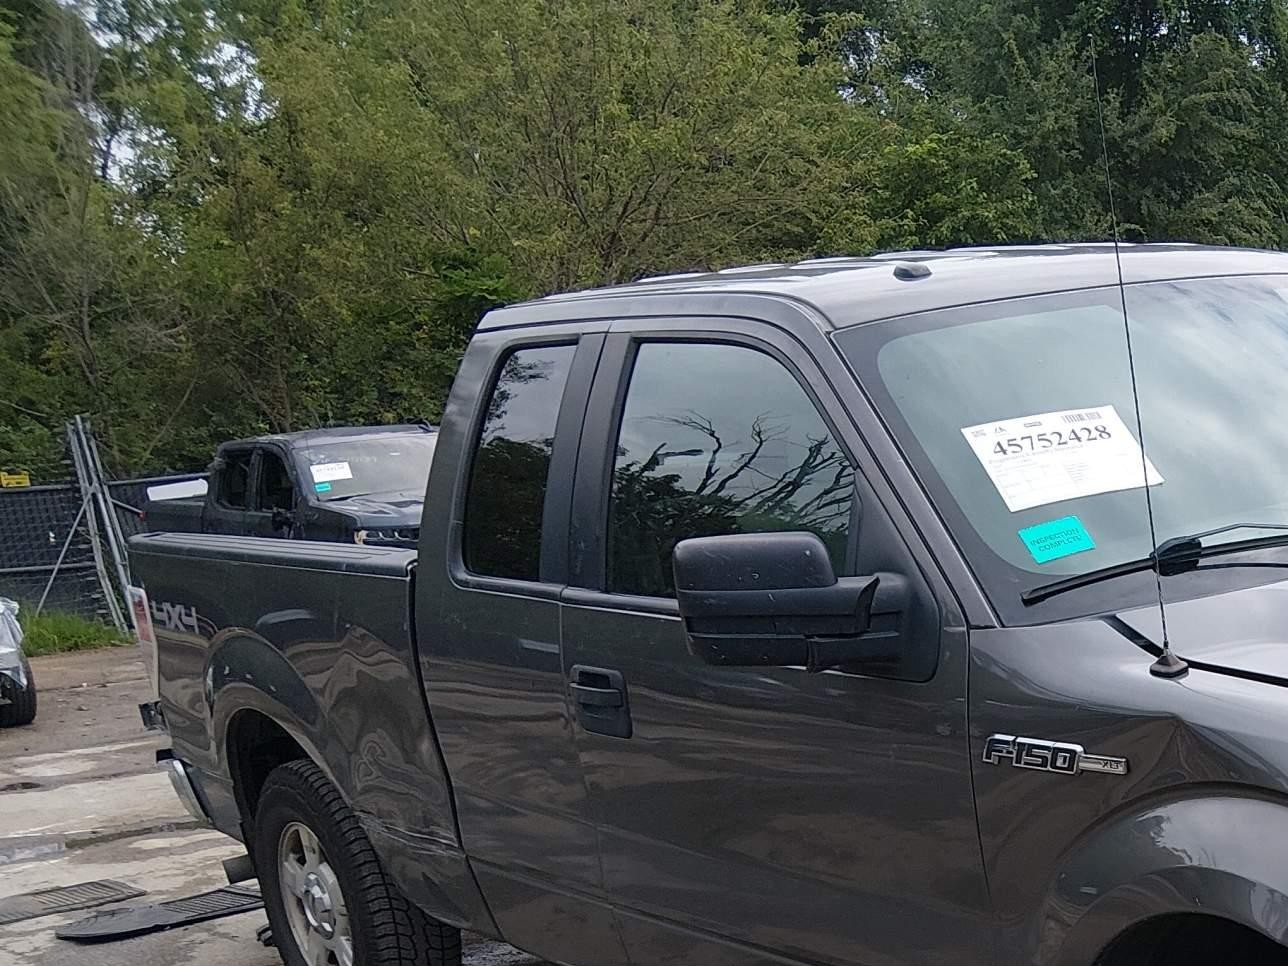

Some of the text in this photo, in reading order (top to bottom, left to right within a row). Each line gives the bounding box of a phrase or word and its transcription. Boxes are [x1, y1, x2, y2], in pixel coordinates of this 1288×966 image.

[993, 425, 1111, 455] 45752428
[1030, 528, 1079, 546] INSPECTION
[1039, 535, 1081, 552] COMPLETE
